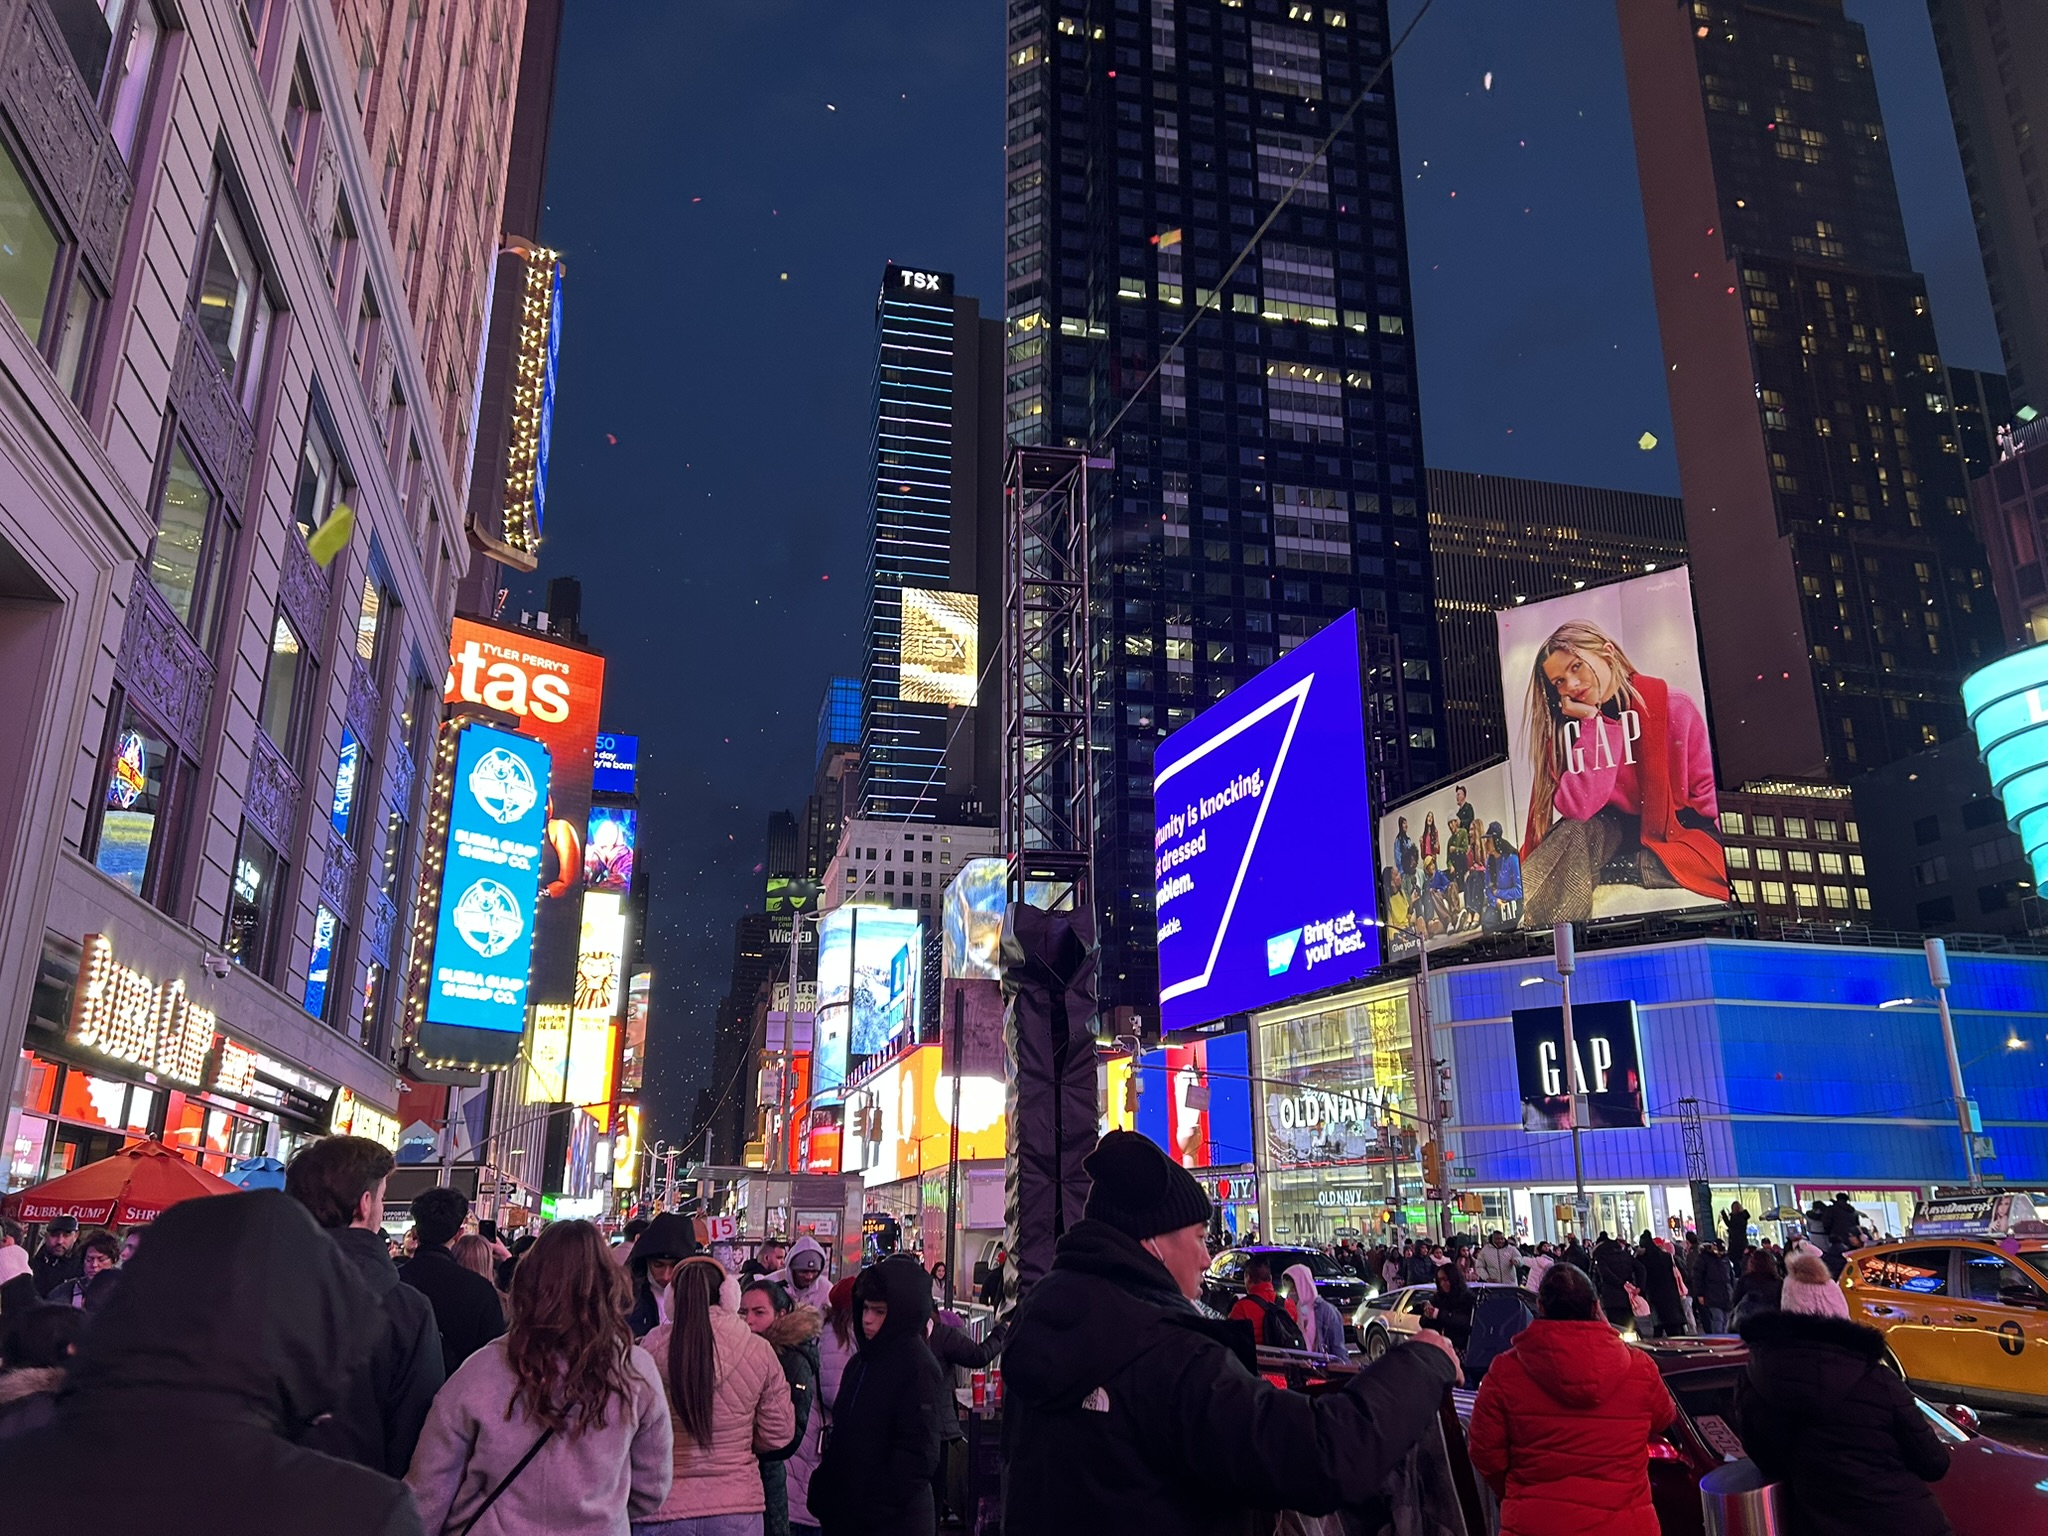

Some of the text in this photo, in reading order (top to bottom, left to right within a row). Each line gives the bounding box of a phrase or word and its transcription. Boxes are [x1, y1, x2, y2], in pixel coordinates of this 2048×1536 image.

[901, 270, 940, 291] TSX
[482, 642, 570, 675] TYLER PERRY'S
[913, 635, 966, 659] TSX
[1564, 710, 1641, 775] GAP
[1187, 804, 1199, 828] is
[1200, 767, 1264, 821] knocking.
[1162, 828, 1206, 873] dressed
[1304, 909, 1356, 945] Bring out
[1501, 900, 1518, 922] GAP
[1305, 929, 1366, 970] your best.
[1539, 1037, 1612, 1096] GAP
[1280, 1085, 1384, 1129] OLD NAVY
[1318, 1189, 1362, 1206] OLD NAVY
